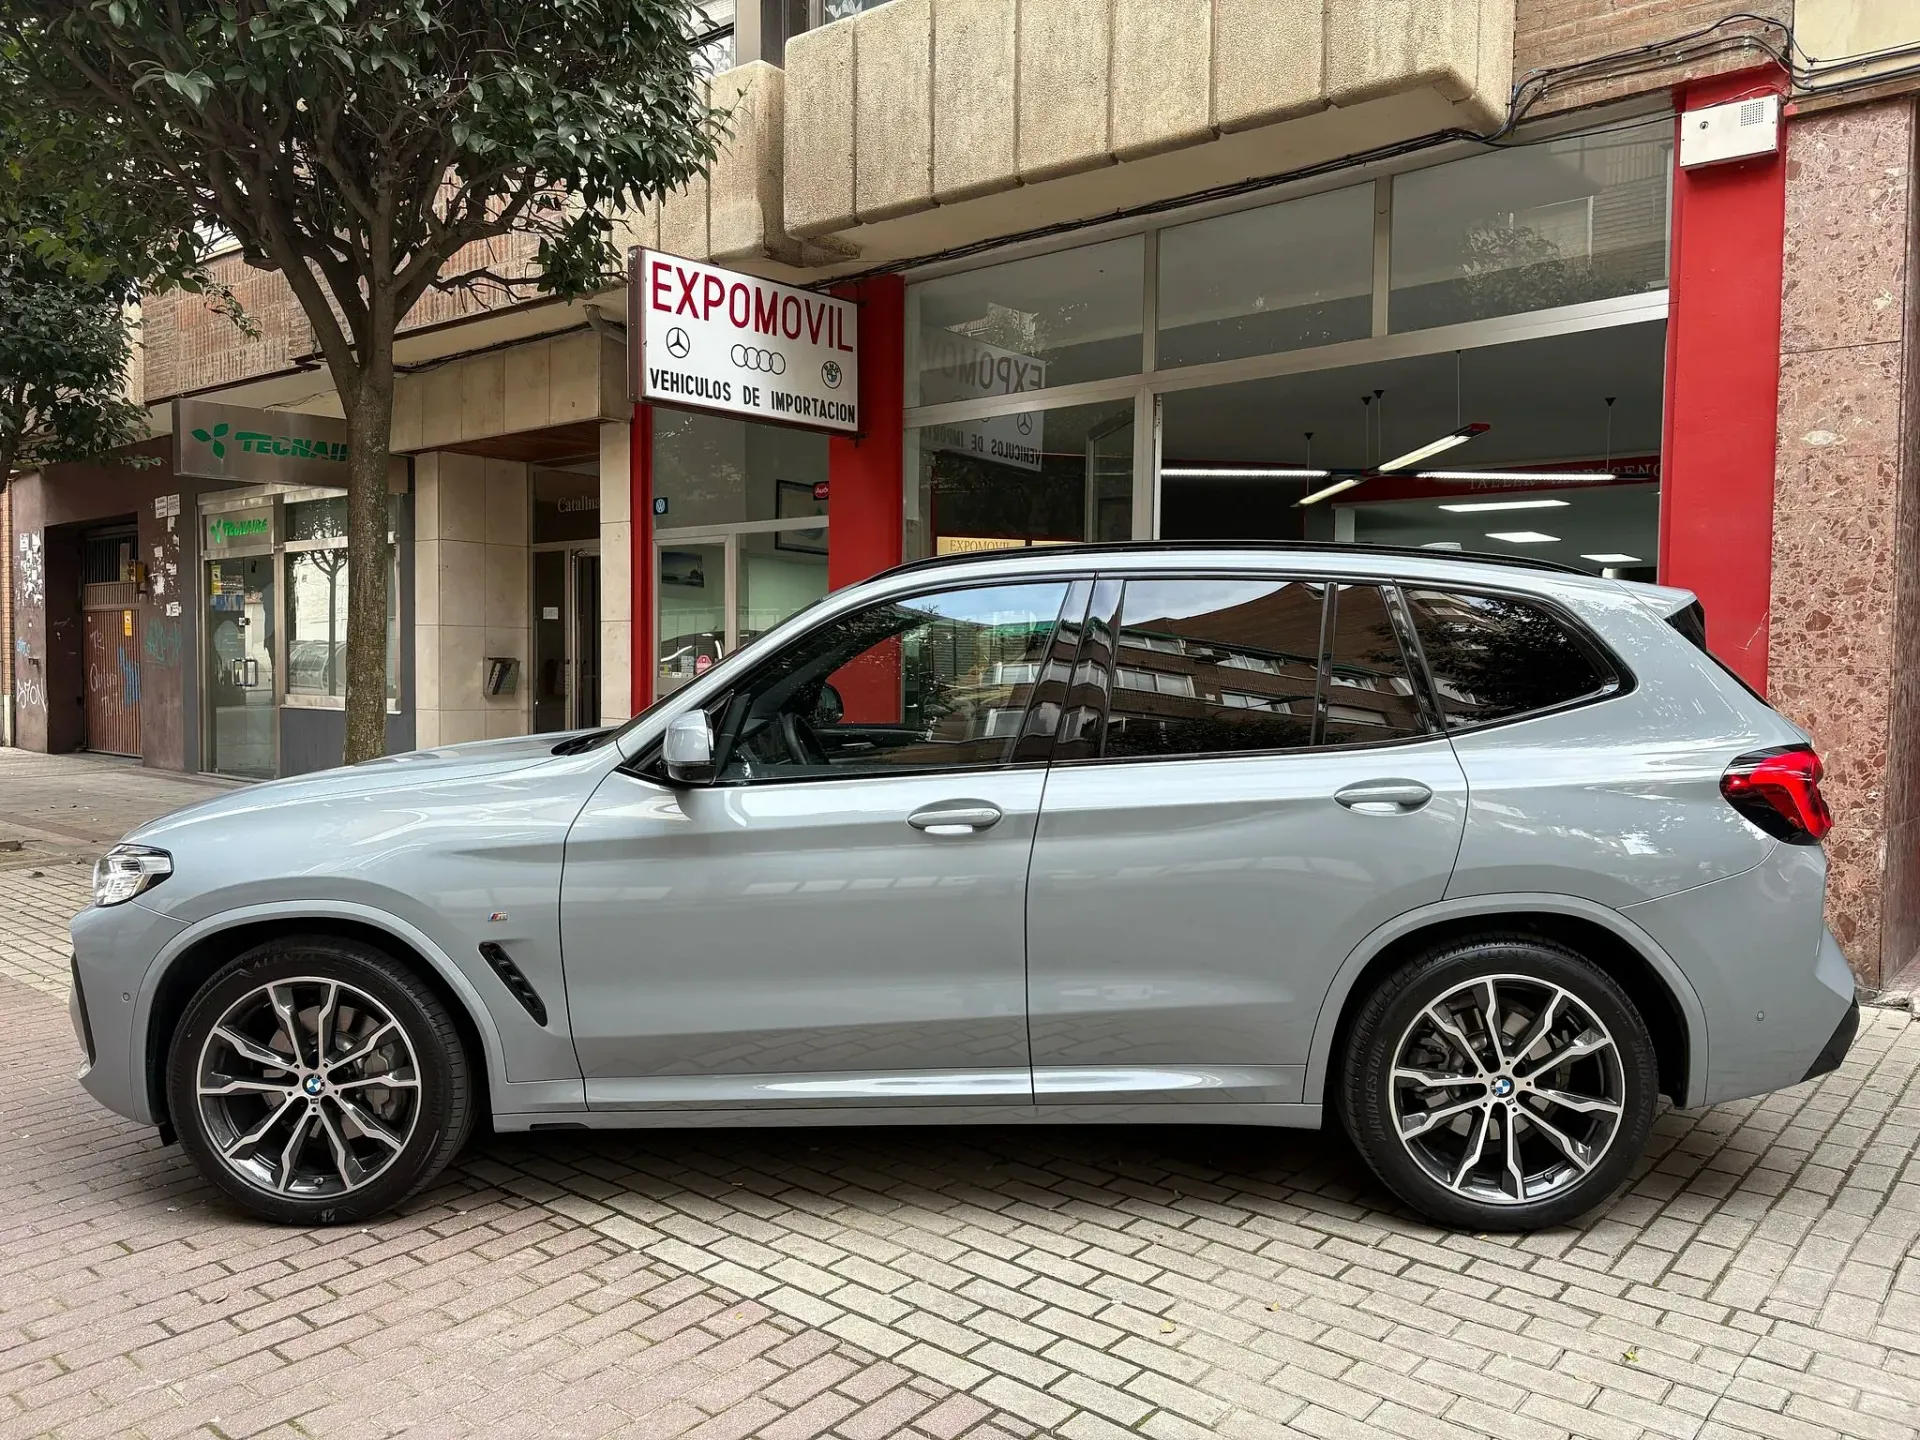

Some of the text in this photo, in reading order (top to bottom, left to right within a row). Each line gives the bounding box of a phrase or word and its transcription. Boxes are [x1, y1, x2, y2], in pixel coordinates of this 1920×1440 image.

[651, 260, 854, 353] EXPOMOVIL
[649, 367, 856, 424] VEHICULOS DE IMPORTACION
